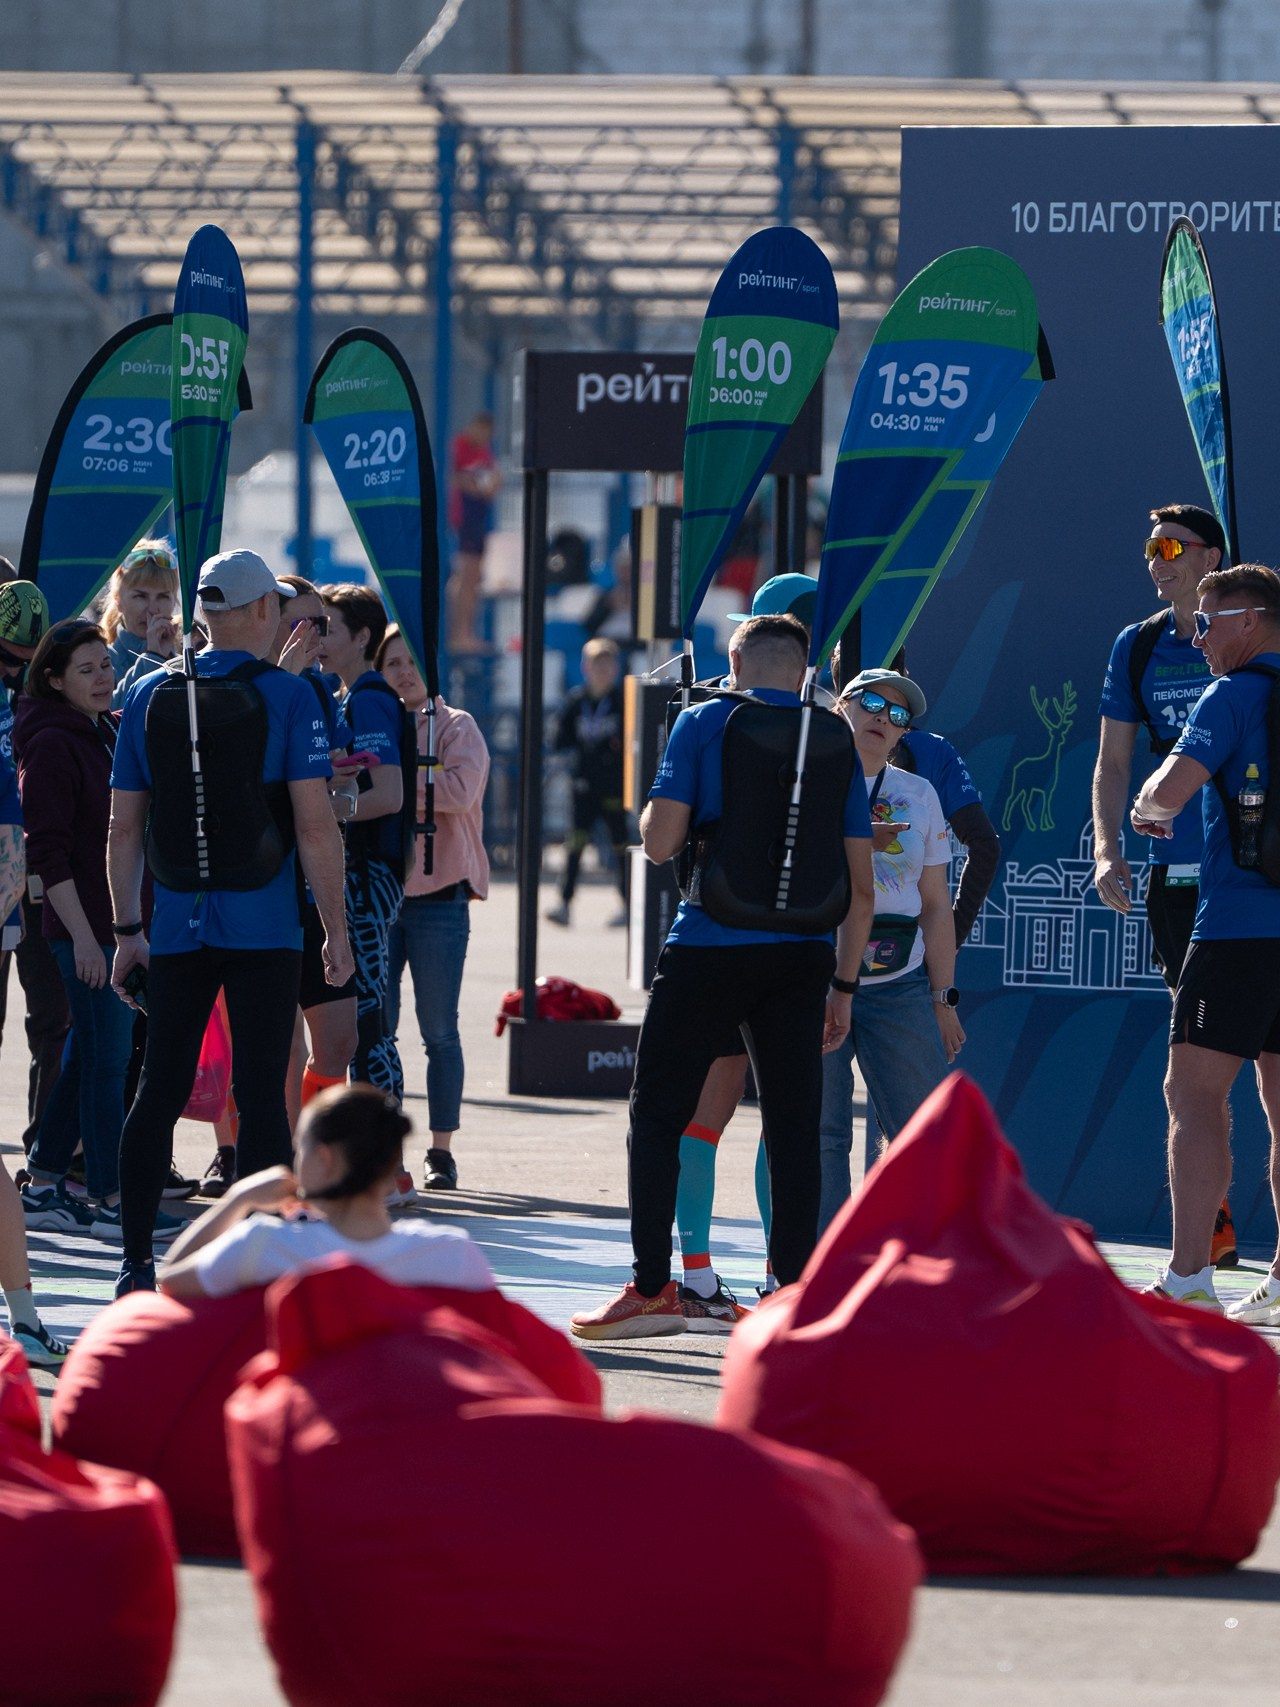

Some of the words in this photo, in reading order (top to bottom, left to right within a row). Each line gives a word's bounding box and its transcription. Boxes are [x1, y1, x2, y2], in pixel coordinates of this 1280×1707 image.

[1011, 202, 1040, 233] 10
[712, 336, 793, 386] 1:00
[577, 362, 691, 413] рейт
[878, 361, 971, 410] 1:35
[870, 412, 921, 432] 04:30
[82, 456, 129, 473] 07:06
[343, 426, 407, 469] 2:20
